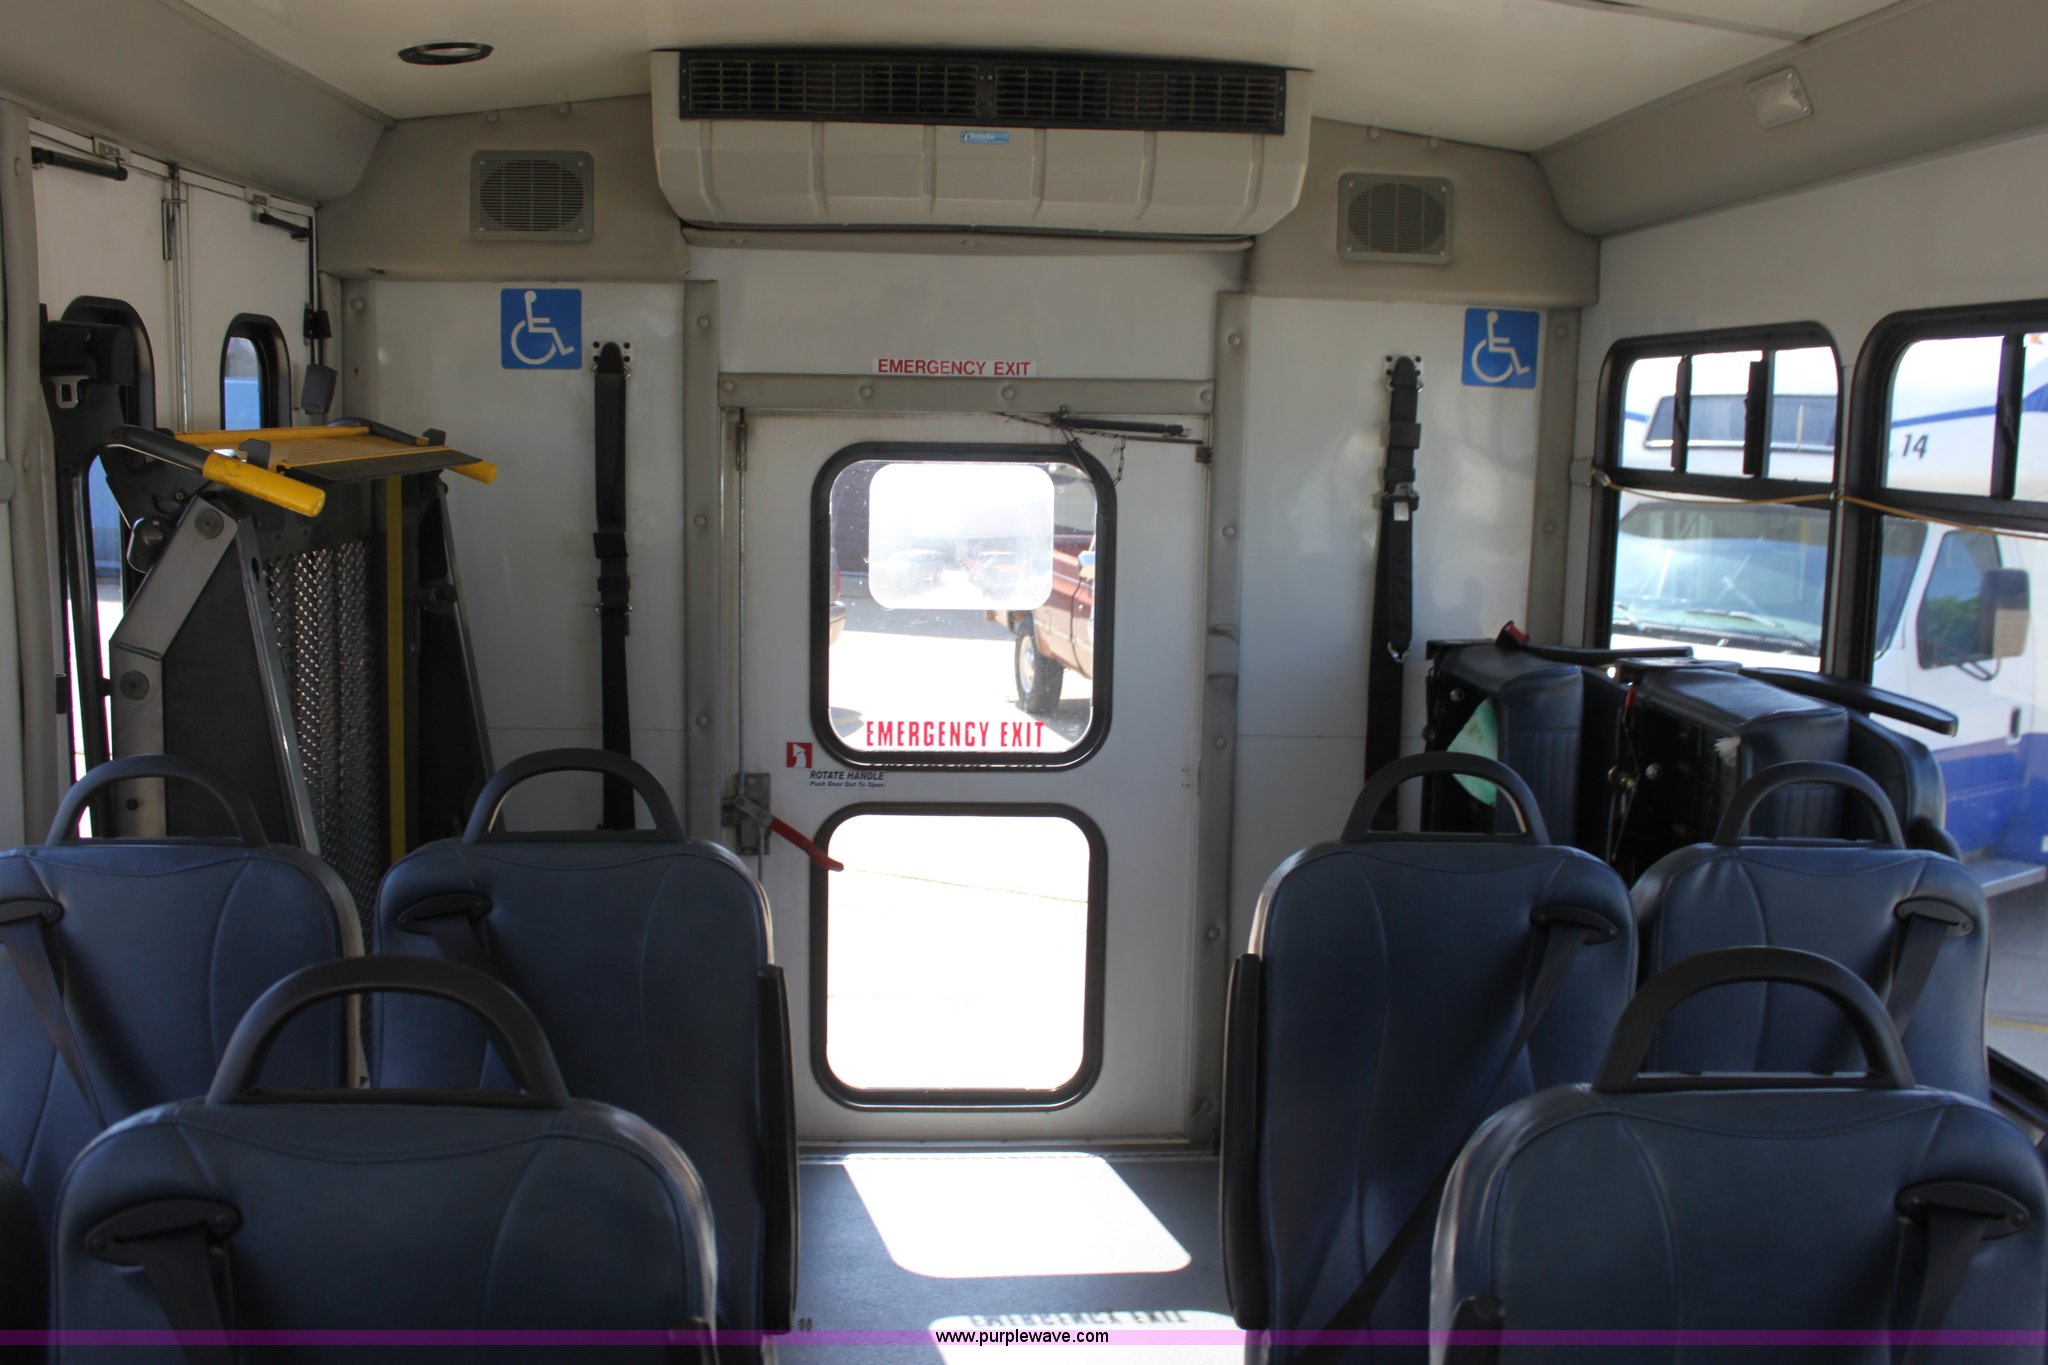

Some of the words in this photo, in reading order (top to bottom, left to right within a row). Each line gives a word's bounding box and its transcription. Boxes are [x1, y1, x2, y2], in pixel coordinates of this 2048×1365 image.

[878, 358, 986, 376] EMERGENCY
[994, 361, 1031, 376] EXIT
[1902, 433, 1928, 459] 14
[866, 720, 989, 747] EMERGENCY
[1000, 721, 1045, 747] EXIT
[810, 770, 844, 780] ROTATE
[847, 771, 884, 781] HANDLE
[868, 781, 884, 789] Open
